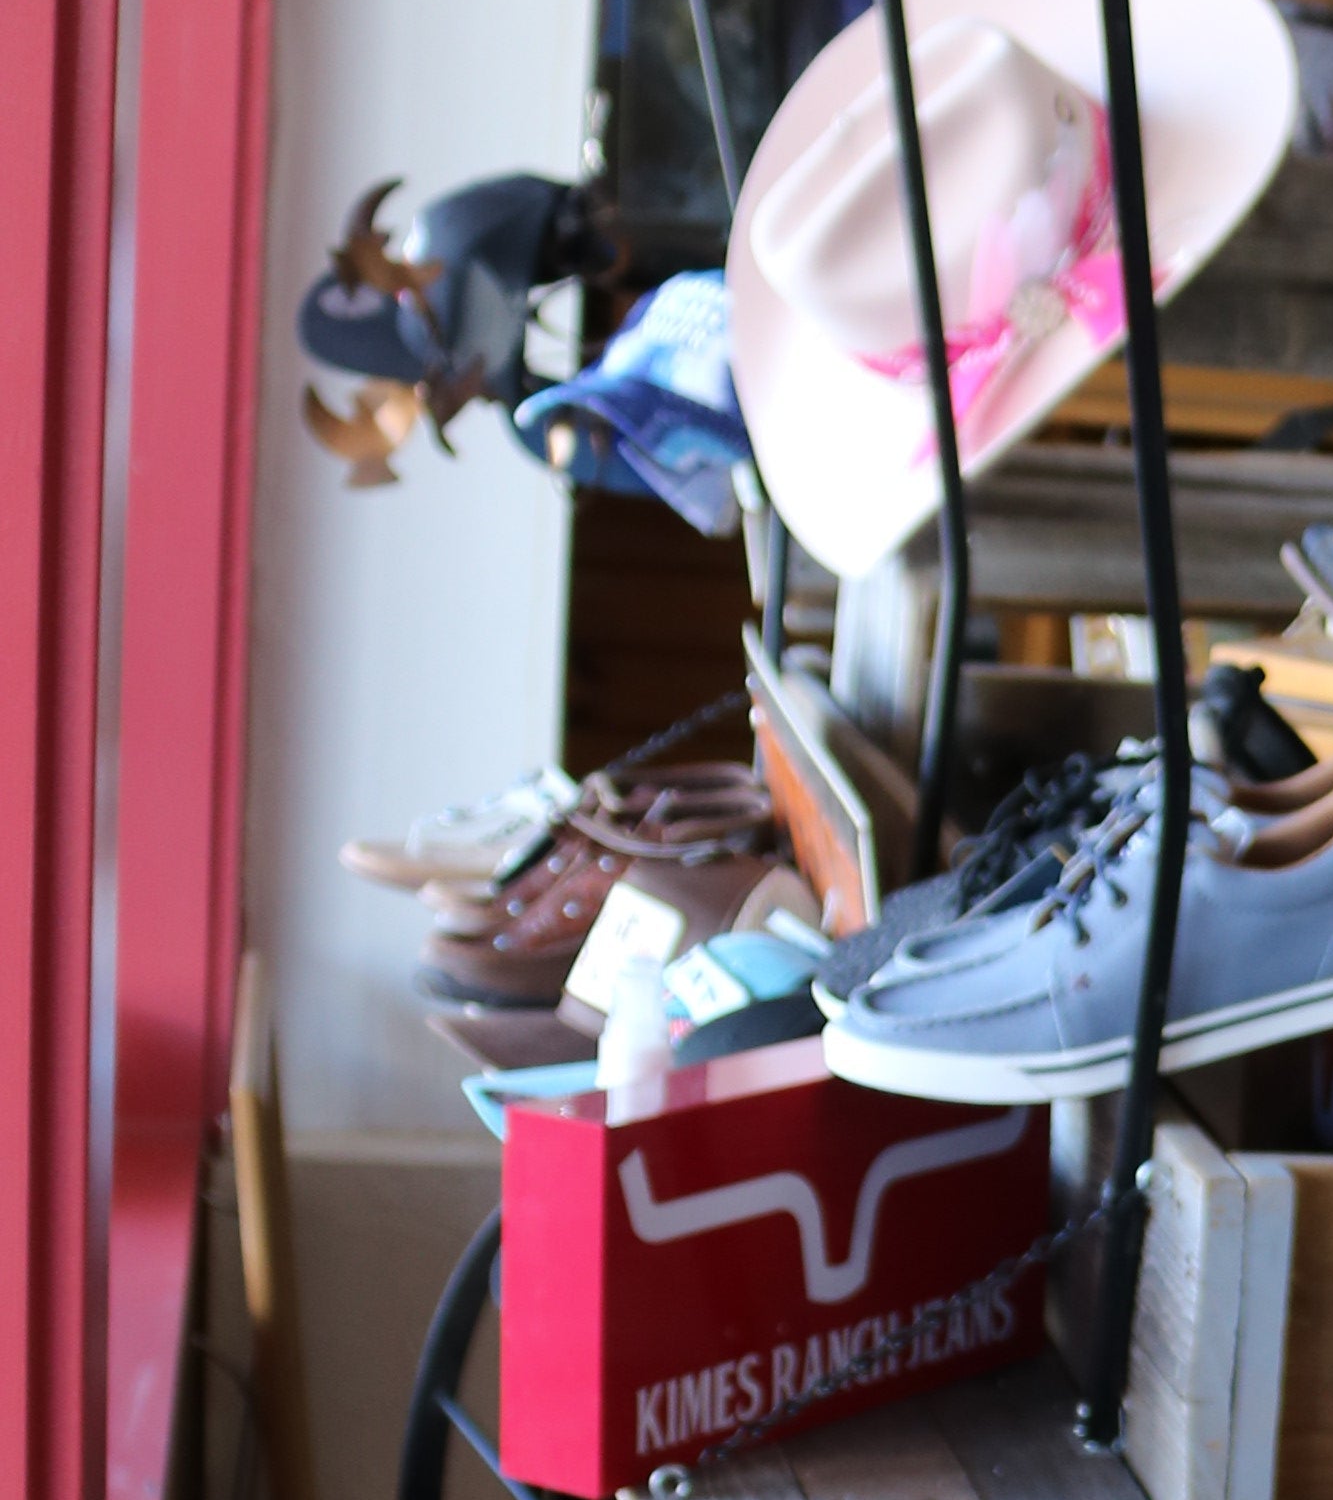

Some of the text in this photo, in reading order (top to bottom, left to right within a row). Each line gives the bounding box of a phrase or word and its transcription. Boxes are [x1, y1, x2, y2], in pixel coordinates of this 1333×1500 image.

[636, 1277, 1016, 1456] KIMES RANCH JEANS
